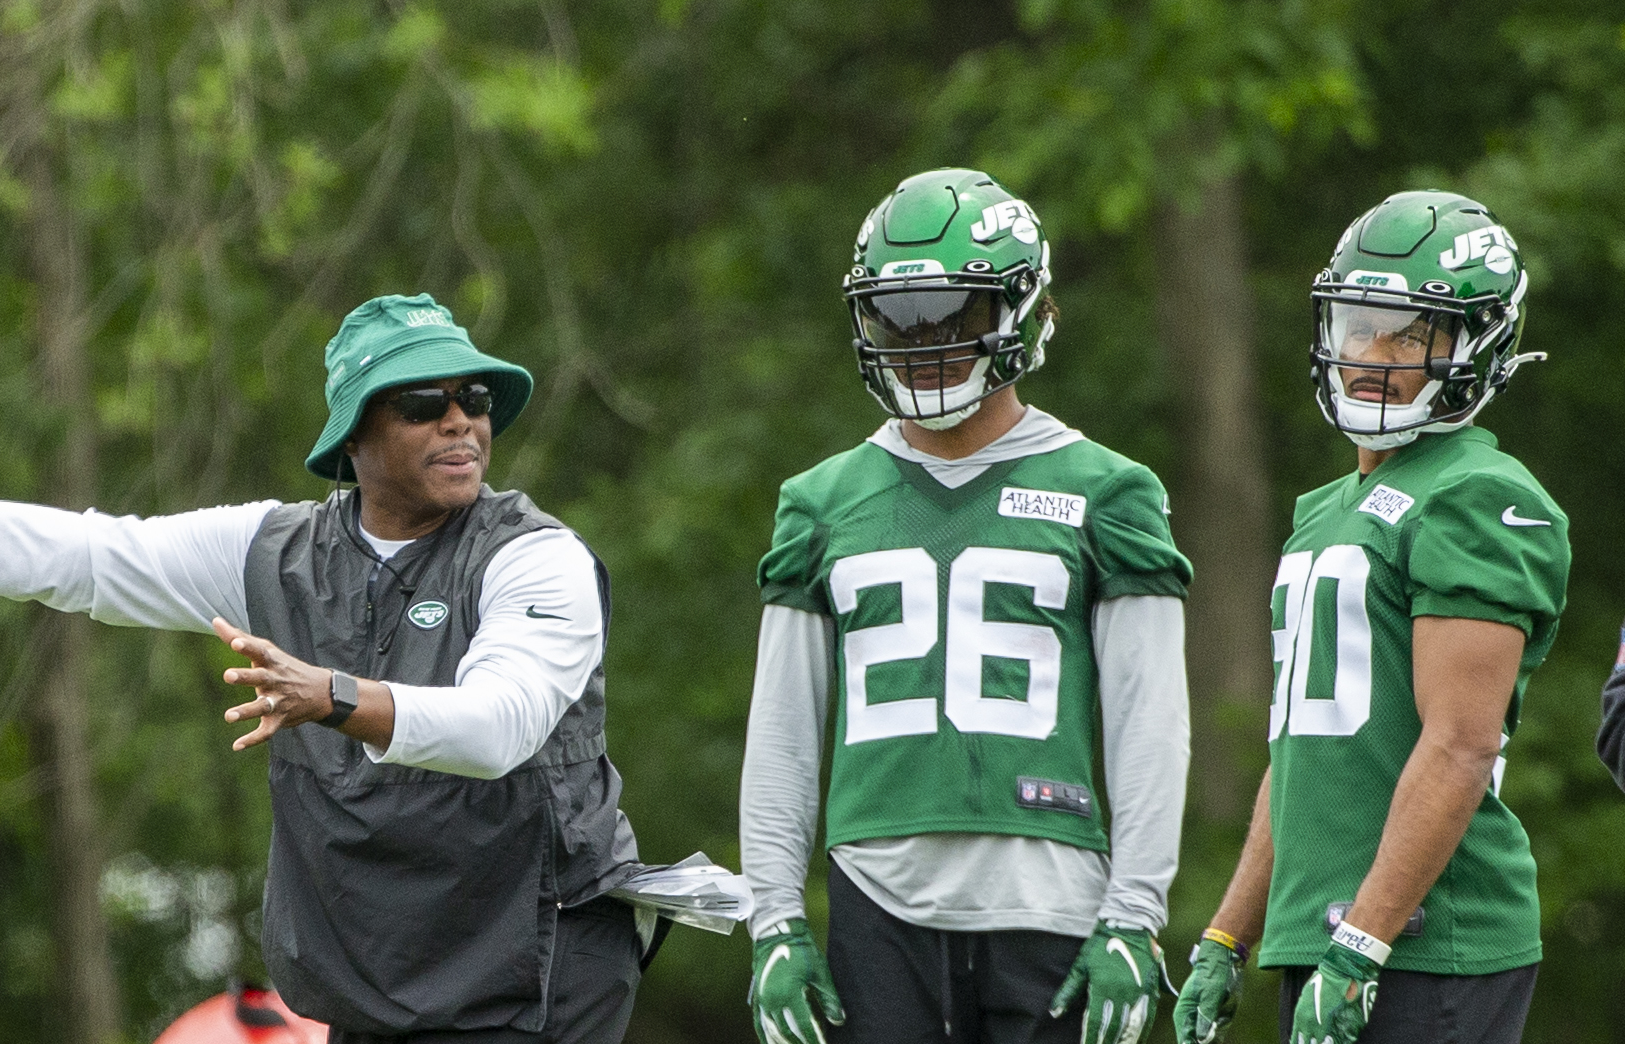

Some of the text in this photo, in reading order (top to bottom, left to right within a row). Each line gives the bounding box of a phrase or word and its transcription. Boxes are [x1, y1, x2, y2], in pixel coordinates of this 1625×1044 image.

[892, 263, 925, 274] JETS
[1355, 275, 1389, 286] JETS
[1003, 491, 1081, 512] ATLANTIC
[1011, 502, 1070, 521] HEALTH
[828, 546, 1071, 746] 26
